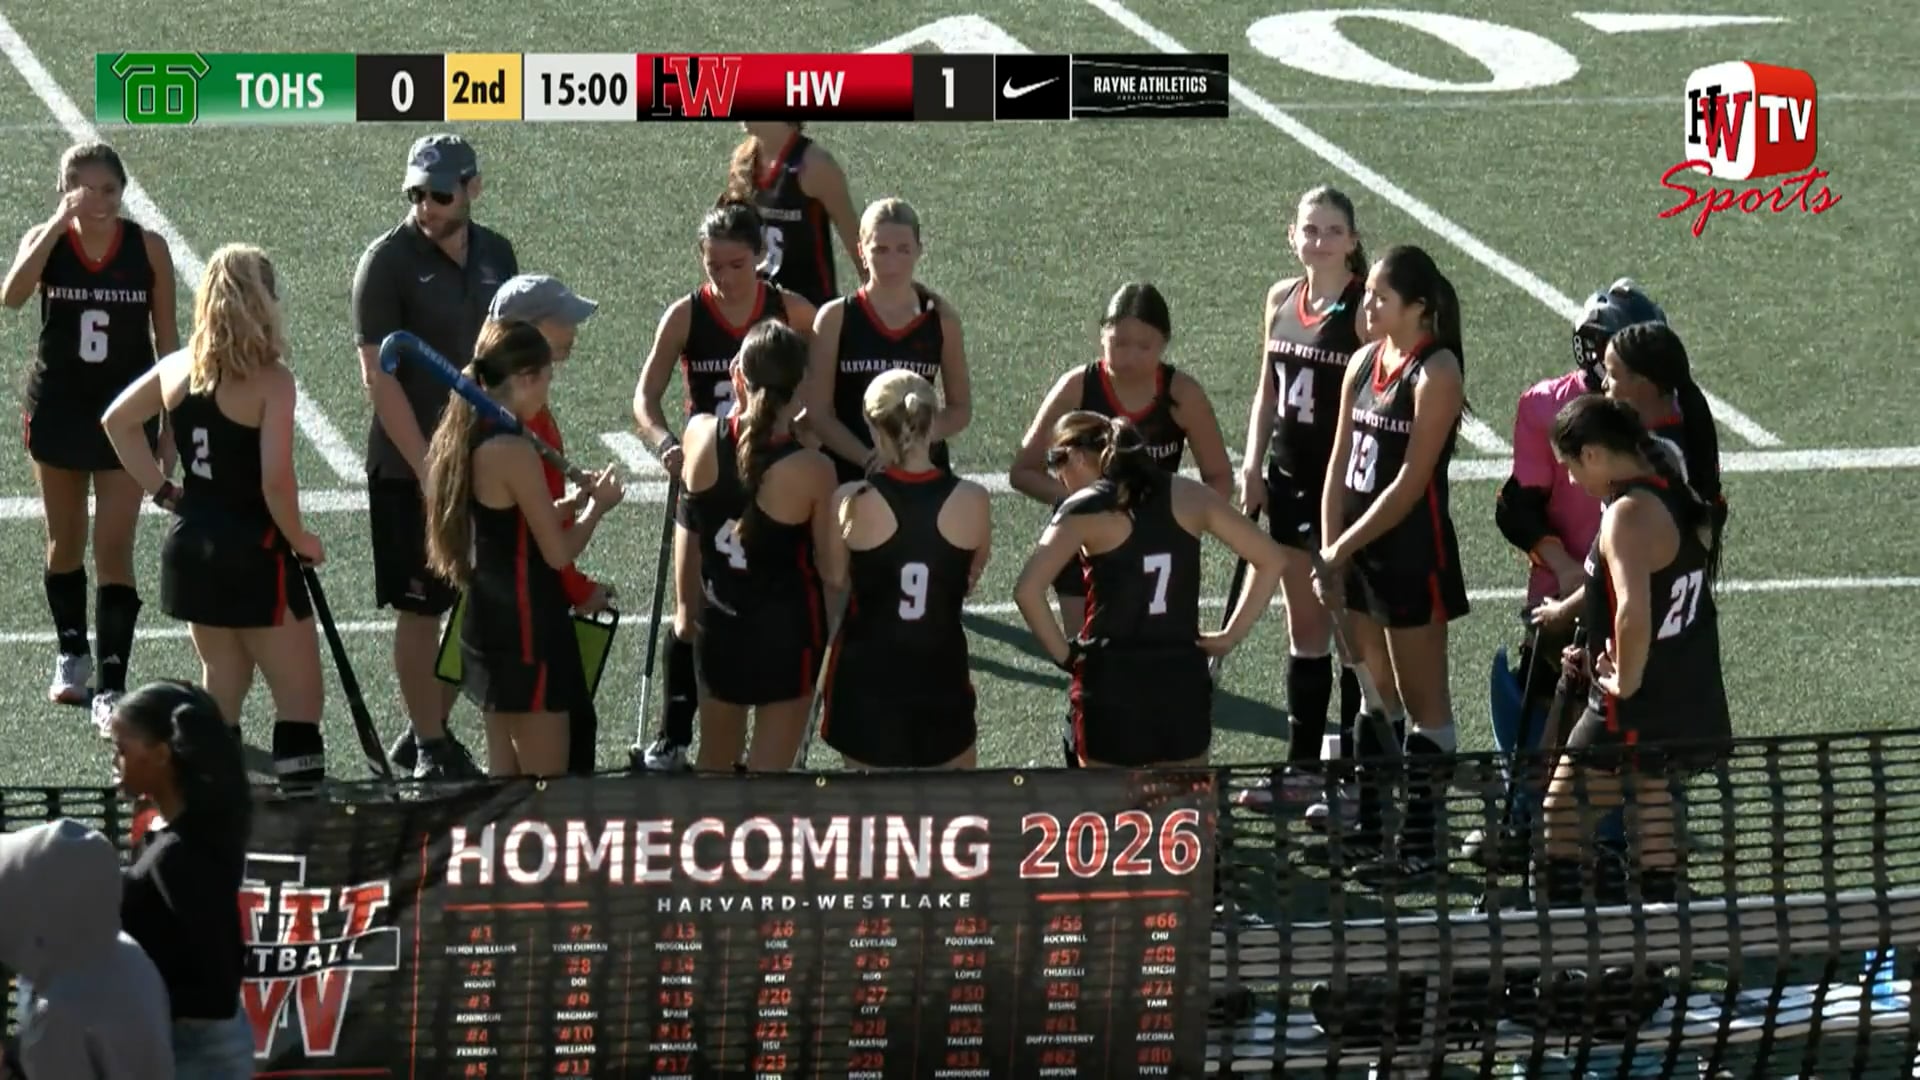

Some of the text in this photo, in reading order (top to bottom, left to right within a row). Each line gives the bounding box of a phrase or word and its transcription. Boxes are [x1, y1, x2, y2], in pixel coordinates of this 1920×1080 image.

[78, 309, 110, 363] 6
[1275, 361, 1316, 424] 14
[191, 427, 213, 480] 2
[714, 518, 748, 570] 4
[899, 562, 929, 620] 9
[1143, 553, 1172, 614] 7
[1657, 569, 1704, 640] 27
[446, 809, 1201, 885] HOMECOMING 2026
[657, 893, 970, 913] HARVARD-WESTLAKE
[1144, 912, 1177, 928] #66
[849, 938, 897, 948] CLEVELAND
[1043, 934, 1088, 944] ROCKWELL
[252, 945, 363, 973] TBALL
[567, 957, 591, 975] #8
[571, 977, 587, 987] DOI
[764, 974, 785, 983] RICH
[567, 992, 589, 1007] #9
[757, 988, 791, 1006] #20
[559, 1026, 593, 1040] #10
[755, 1022, 788, 1039] #21
[555, 1044, 596, 1054] WILLIAMS
[762, 1041, 780, 1050] HSU
[556, 1059, 589, 1075] #11
